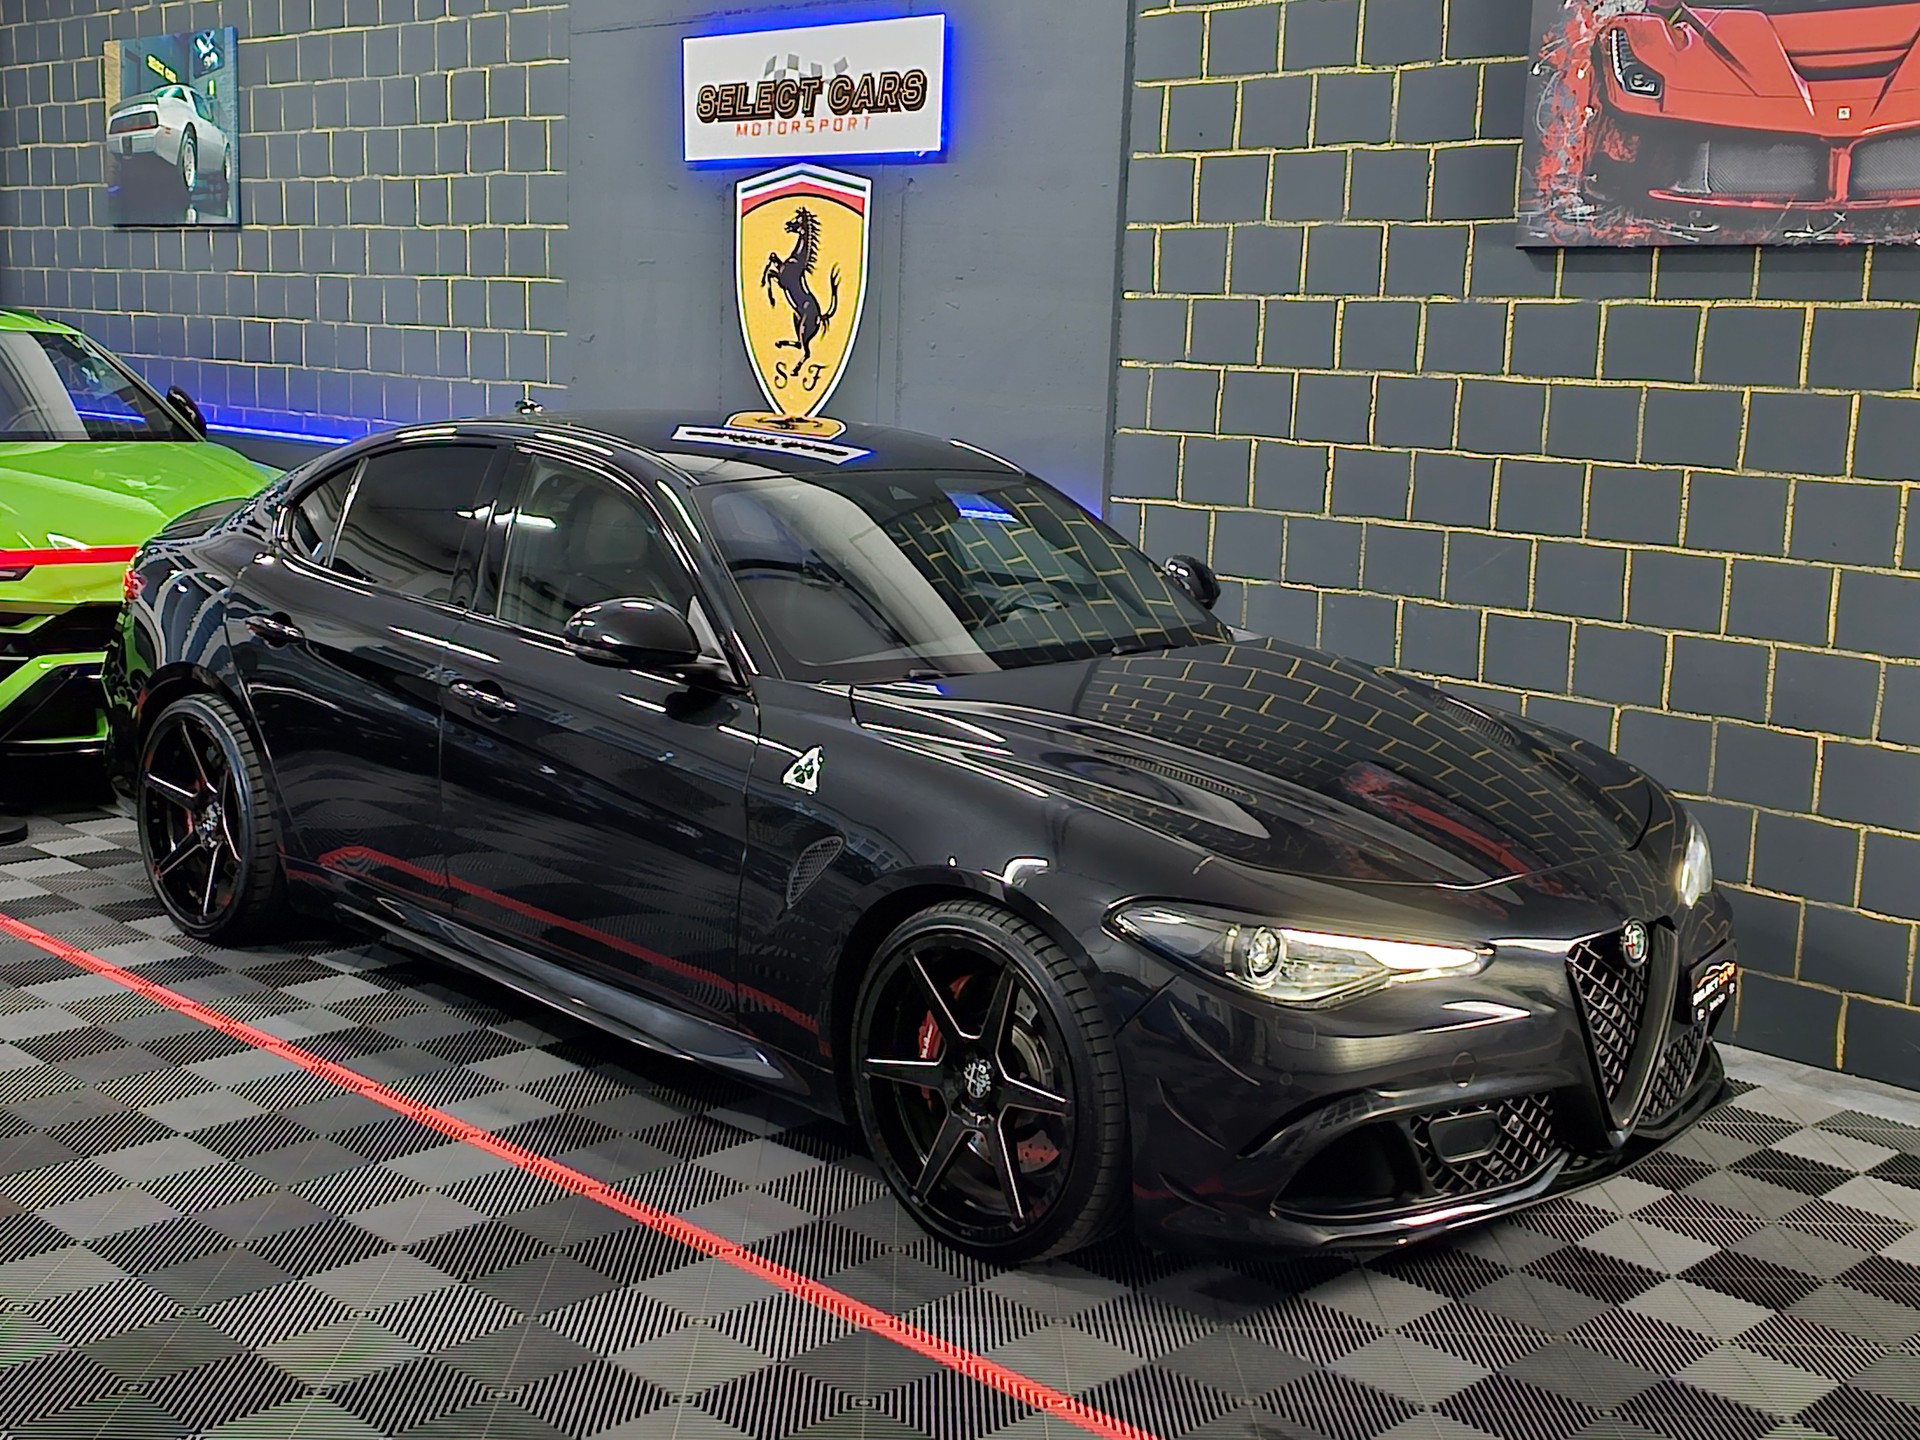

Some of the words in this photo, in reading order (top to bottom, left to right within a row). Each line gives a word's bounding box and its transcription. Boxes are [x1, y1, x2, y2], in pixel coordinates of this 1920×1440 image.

[697, 75, 823, 123] SELECT
[828, 69, 927, 115] CARS
[736, 117, 871, 136] MOTORSPORT
